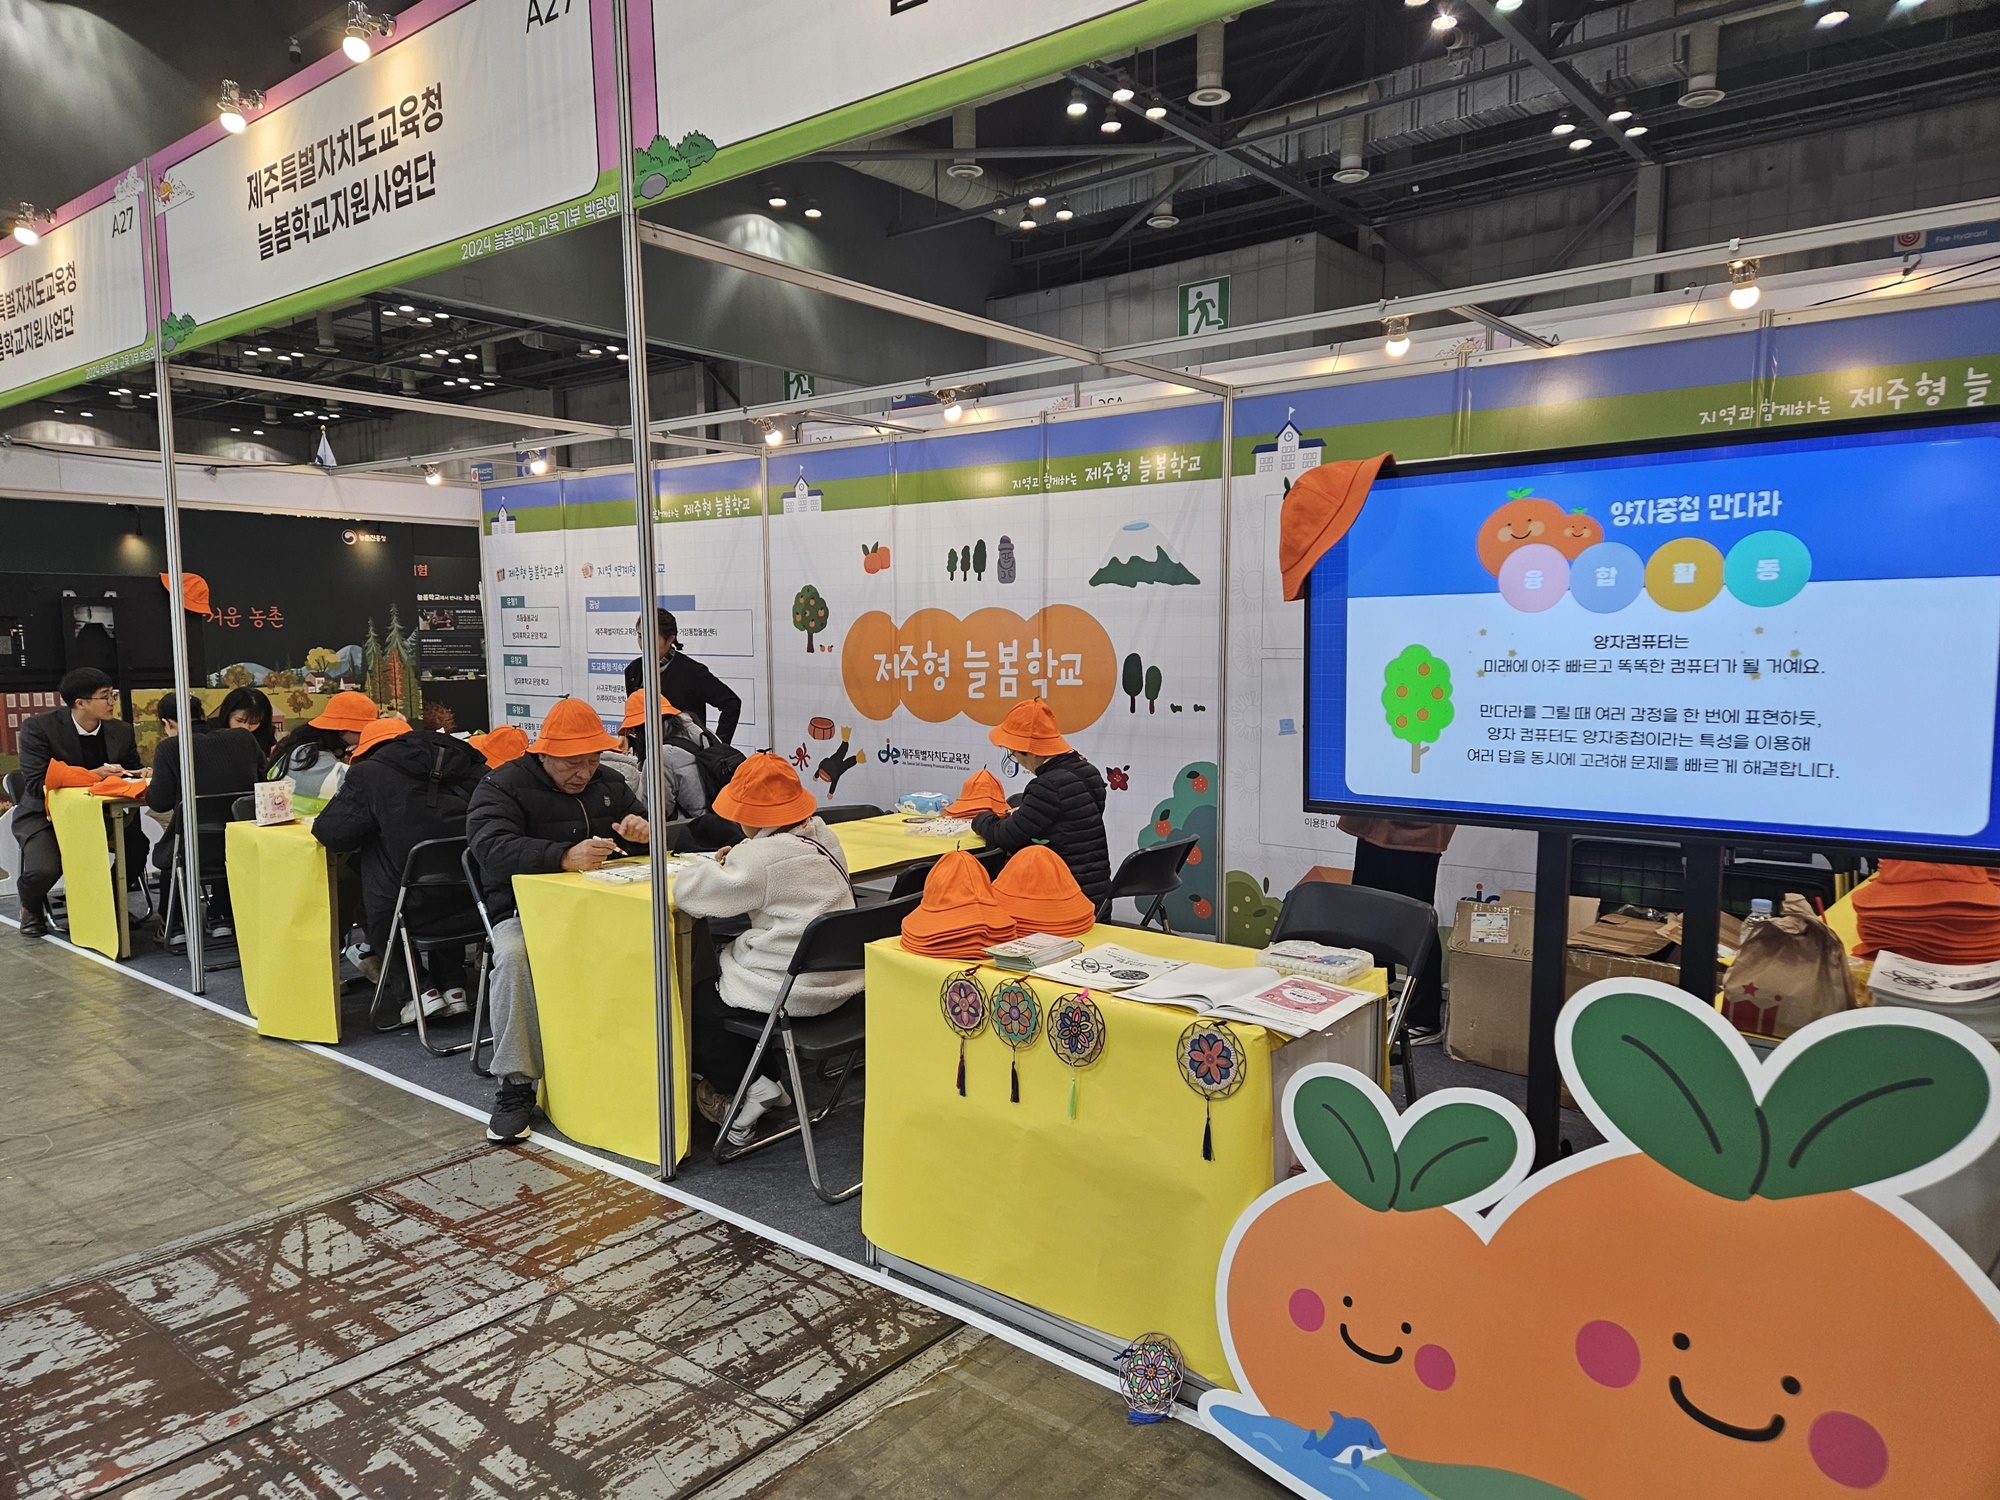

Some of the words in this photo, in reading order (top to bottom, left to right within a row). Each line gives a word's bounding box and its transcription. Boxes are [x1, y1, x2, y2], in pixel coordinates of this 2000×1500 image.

[246, 81, 444, 211] 제주특별자치도교육청
[258, 150, 436, 261] 늘봄학교지원사업단
[112, 206, 134, 239] A27
[461, 235, 492, 261] 2024
[584, 192, 620, 221] 박람회
[1699, 404, 1756, 426] 지역과
[1849, 372, 1947, 410] 제주형
[1085, 458, 1131, 484] 제주형
[1138, 451, 1201, 483] 늘봄학교
[683, 498, 712, 517] 제주형
[715, 494, 751, 517] 늘봄학교
[1610, 495, 1701, 527] 양자중첩
[1707, 489, 1783, 520] 만다라
[414, 564, 428, 577] 험
[597, 564, 613, 579] 지역
[249, 605, 285, 628] 농촌
[1593, 634, 1690, 650] 양자컴퓨터는
[873, 639, 950, 692] 제주형
[963, 637, 1084, 699] 늘봄학교
[1484, 659, 1528, 673] 미래에
[1531, 659, 1561, 673] 아주
[1565, 659, 1613, 673] 빠르고
[1617, 658, 1666, 674] 똑똑한
[1671, 658, 1738, 674] 컴퓨터가
[1742, 658, 1760, 674] 될
[1765, 658, 1826, 674] 거예요.
[1480, 704, 1537, 719] 만다라를
[1541, 705, 1571, 720] 그릴
[1574, 706, 1591, 721] 때
[1595, 706, 1626, 721] 여러
[1631, 707, 1679, 723] 감정을
[1683, 707, 1701, 724] 한
[1705, 709, 1740, 724] 번에
[1744, 709, 1822, 728] 표현하듯,
[1487, 726, 1516, 741] 양자
[1520, 727, 1578, 743] 컴퓨터도
[1582, 729, 1694, 748] 양자중첩이라는
[1699, 733, 1750, 750] 특성을
[1755, 735, 1812, 751] 이용해
[902, 748, 970, 765] 제주특별자치도교육청
[1467, 748, 1494, 763] 여러
[1498, 749, 1526, 764] 답을
[1531, 750, 1576, 767] 동시에
[1579, 752, 1627, 769] 고려해
[1631, 755, 1679, 772] 문제를
[1684, 757, 1738, 774] 빠르게
[1743, 759, 1840, 779] 해결합니다.
[1304, 817, 1329, 830] 이용한
